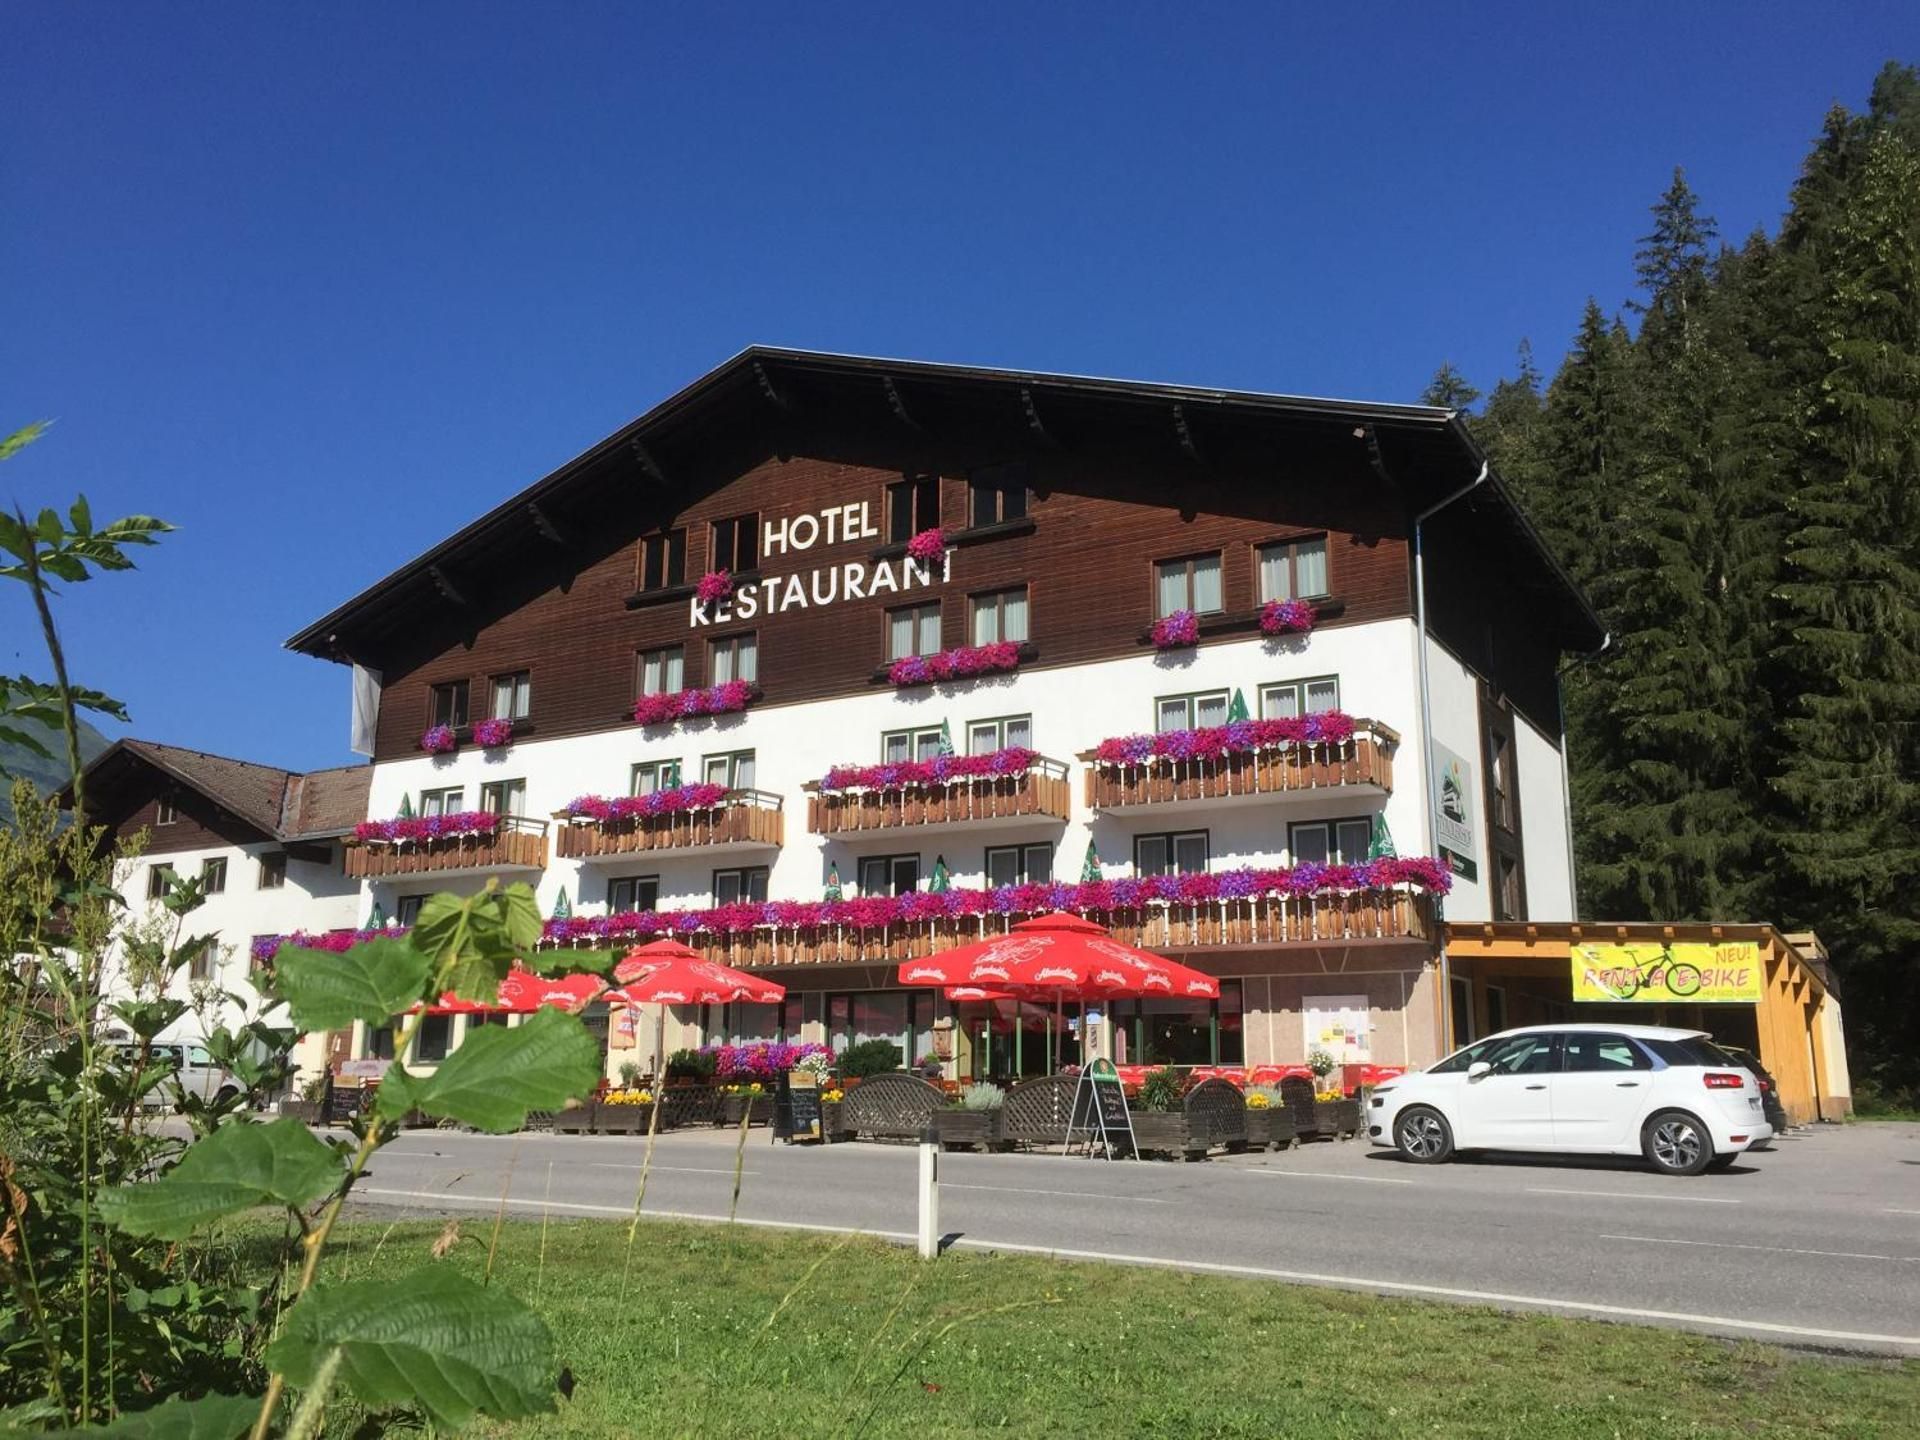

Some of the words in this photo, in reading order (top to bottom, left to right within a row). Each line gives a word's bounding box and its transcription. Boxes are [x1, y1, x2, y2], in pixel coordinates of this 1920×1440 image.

[764, 501, 879, 557] HOTEL
[689, 545, 958, 628] RESTAURANT
[1715, 946, 1751, 965] NEU!
[1583, 968, 1642, 987] RENT
[1649, 968, 1665, 987] A
